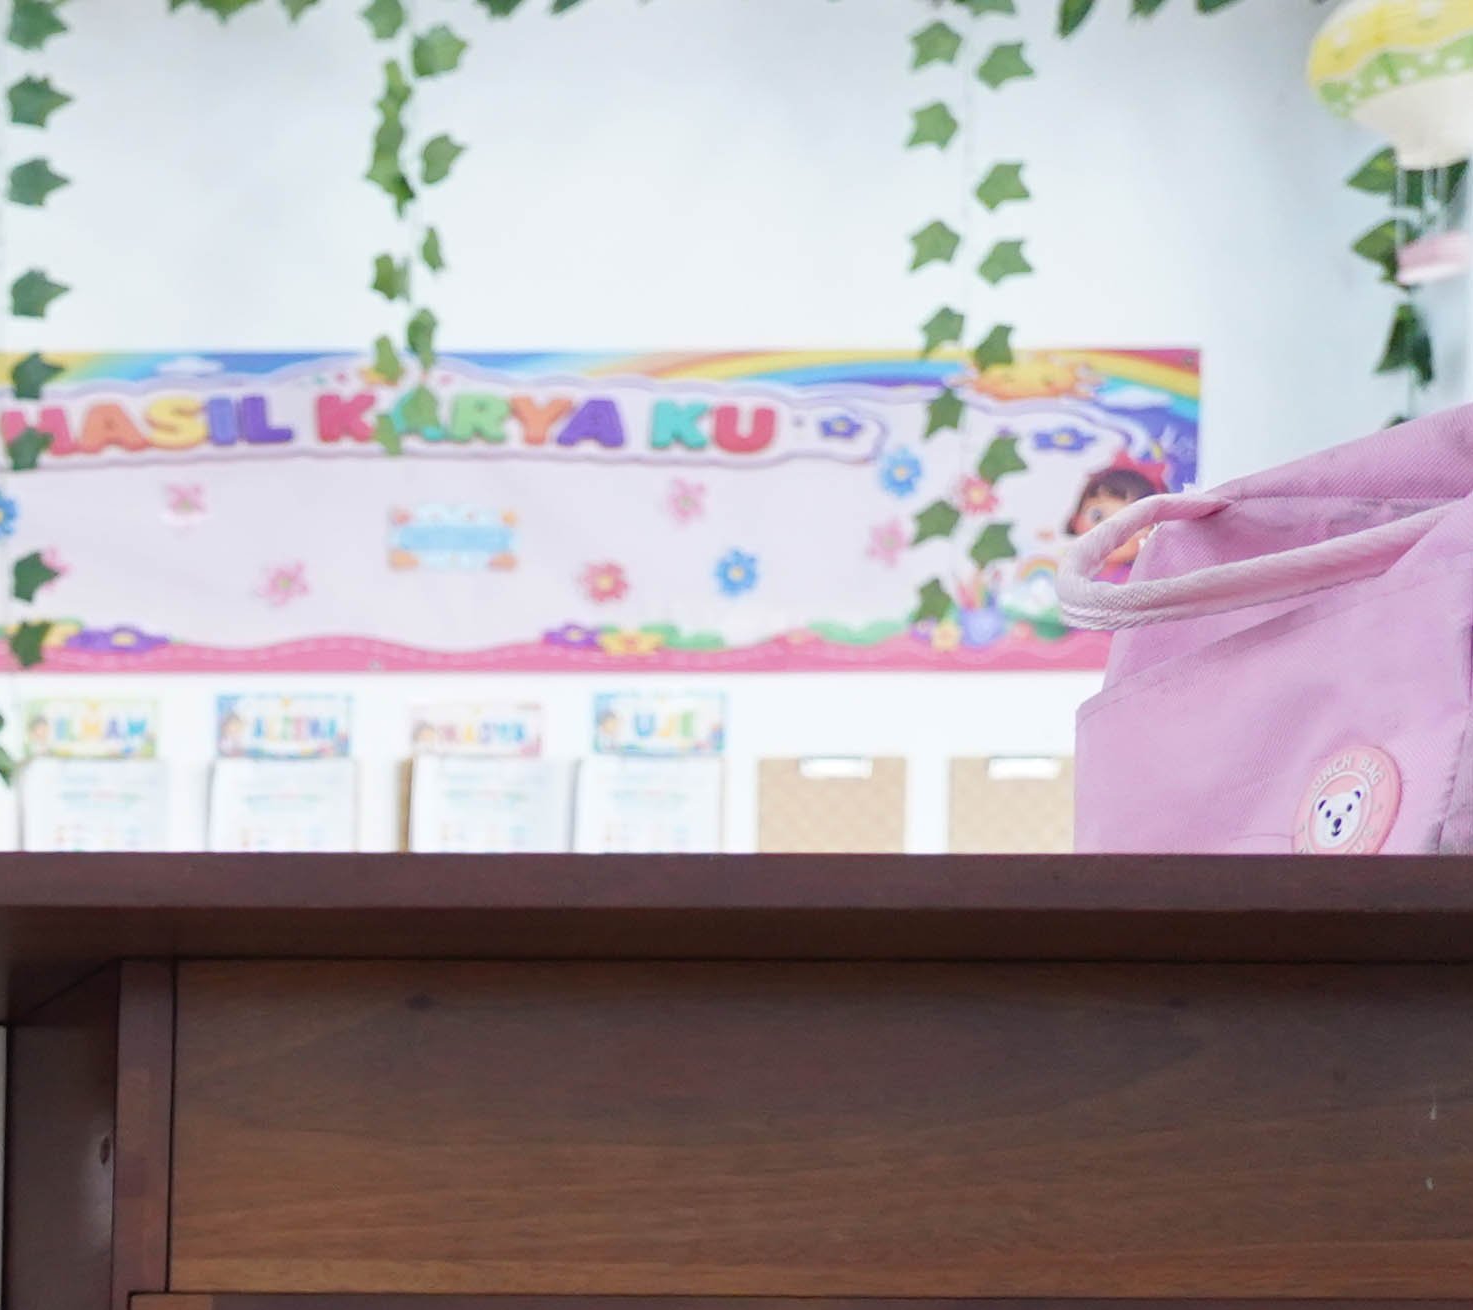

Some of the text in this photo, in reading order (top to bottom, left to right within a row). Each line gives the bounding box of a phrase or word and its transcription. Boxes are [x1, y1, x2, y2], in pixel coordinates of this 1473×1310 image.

[0, 395, 294, 456] HASIL
[651, 399, 777, 454] KU
[1359, 757, 1386, 785] BAG
